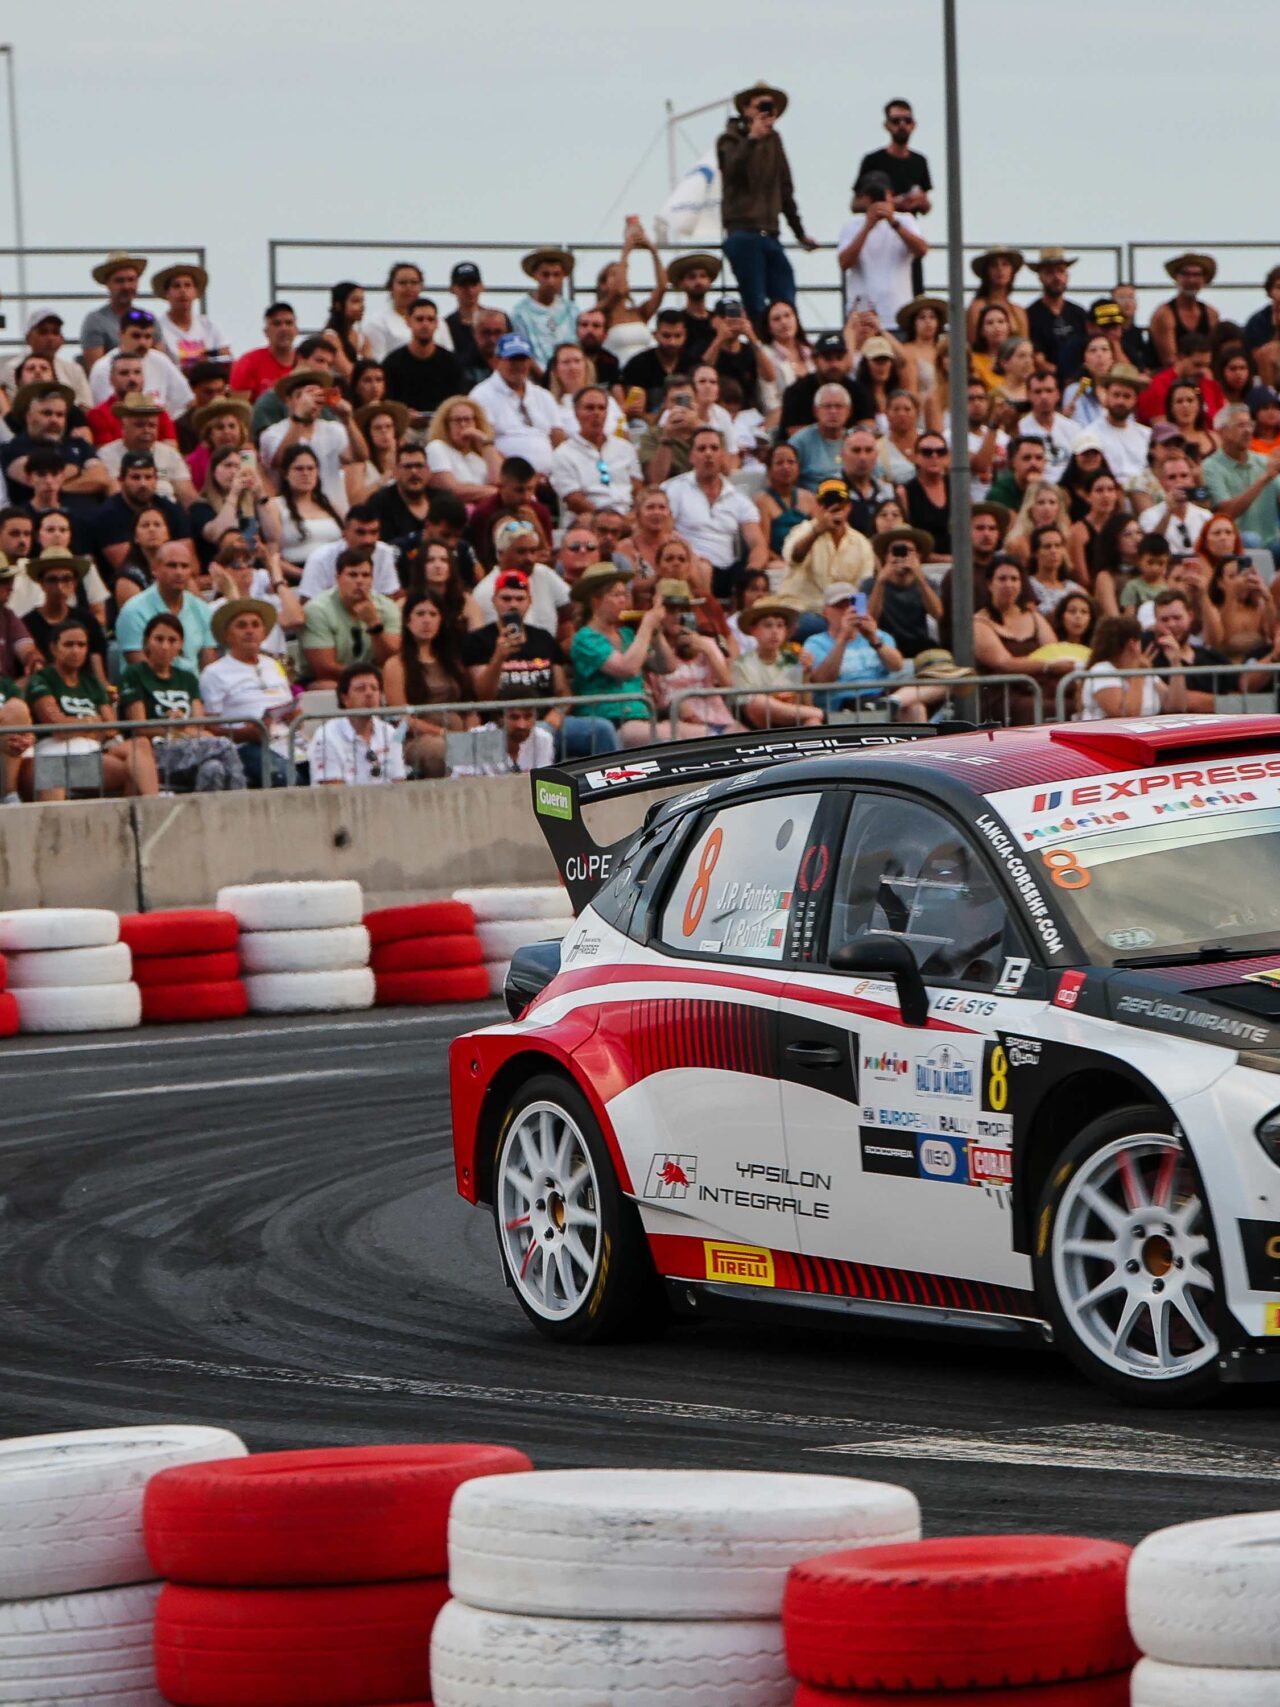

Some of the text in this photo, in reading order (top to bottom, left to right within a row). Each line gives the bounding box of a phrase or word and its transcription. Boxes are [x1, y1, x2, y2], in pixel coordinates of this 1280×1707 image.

[671, 748, 852, 774] INTEGR
[736, 736, 918, 756] YPSILON
[540, 787, 569, 810] Guerin
[682, 827, 724, 937] 8
[1042, 849, 1091, 889] 8
[740, 883, 777, 912] Fontes
[734, 920, 769, 949] Ponte
[934, 995, 999, 1017] LEASYS
[1116, 996, 1188, 1023] REFÚGIO
[1183, 1009, 1272, 1043] MIRANTE
[989, 1045, 1009, 1111] 8
[736, 1161, 832, 1191] YPSILON
[699, 1185, 830, 1220] INTEGRALE
[711, 1248, 768, 1279] PIRELLI
